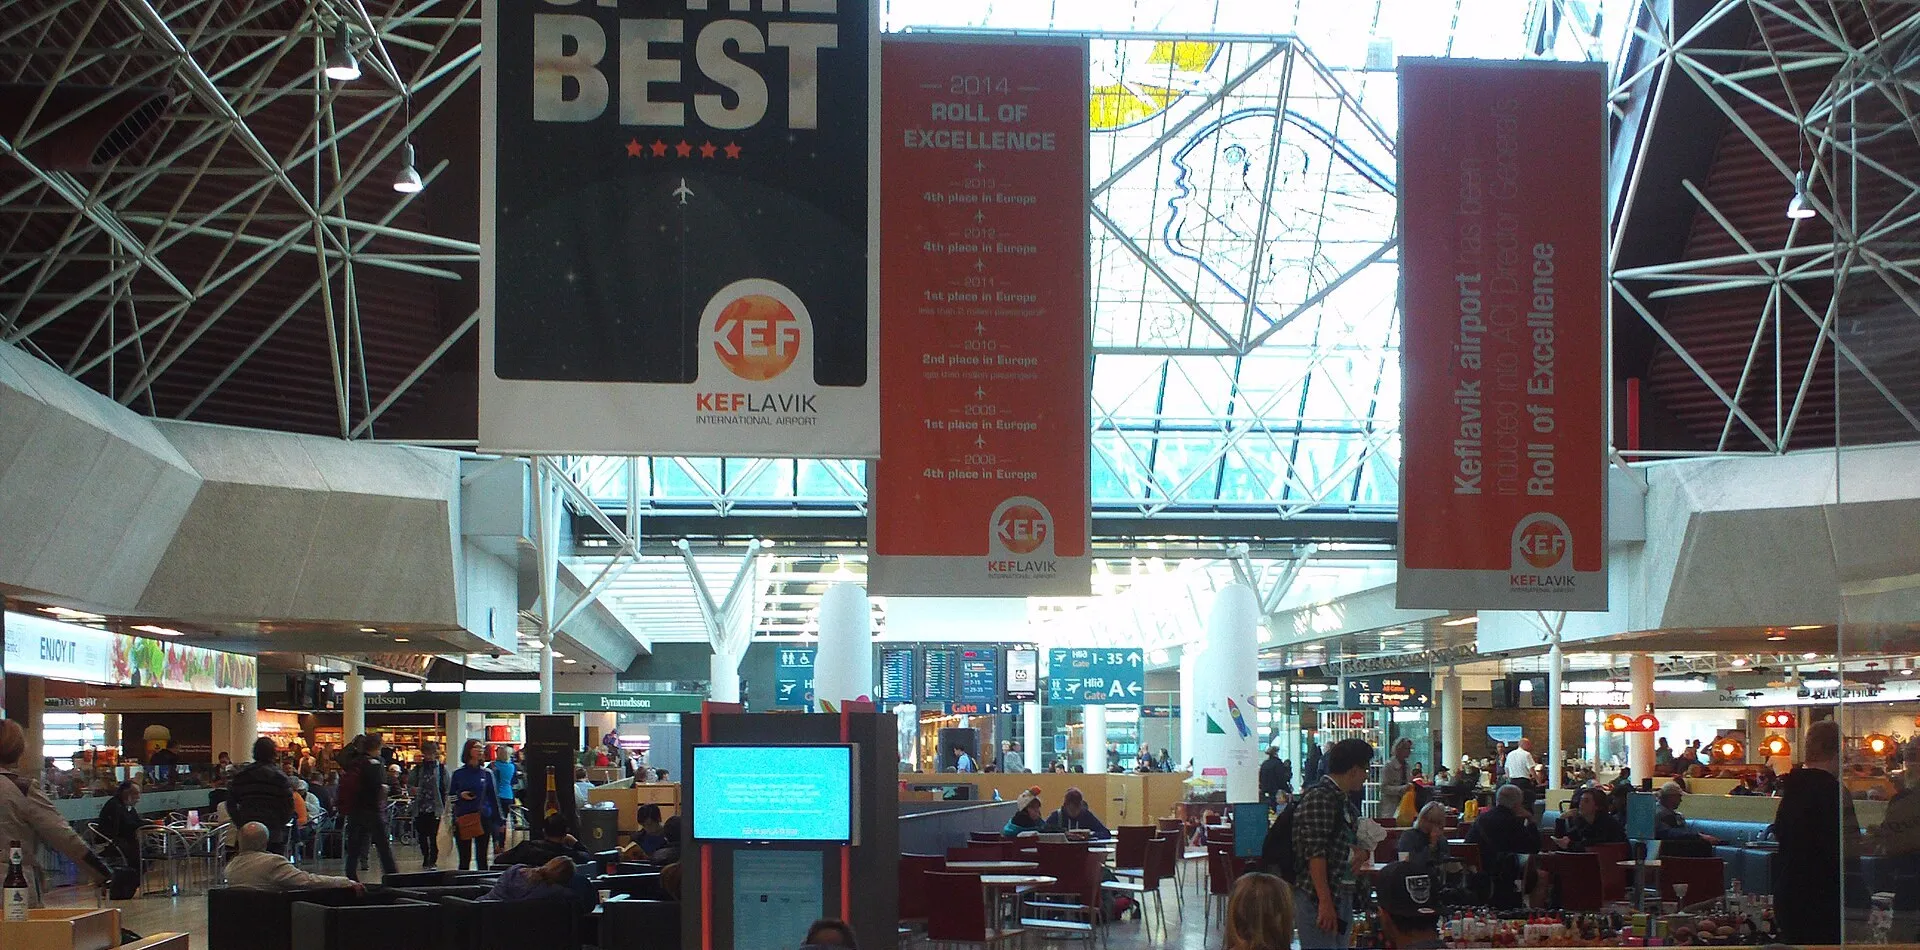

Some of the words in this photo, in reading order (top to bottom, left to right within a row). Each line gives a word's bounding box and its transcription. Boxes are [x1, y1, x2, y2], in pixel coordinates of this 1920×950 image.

[533, 13, 838, 129] BEST
[950, 75, 1011, 96] 2014
[931, 102, 990, 122] ROLL
[998, 103, 1029, 122] OF
[903, 129, 1056, 151] EXCELLENCE
[922, 191, 944, 203] 4th
[947, 192, 978, 205] place
[981, 192, 992, 203] in
[996, 192, 1038, 206] Europe
[922, 240, 944, 252] 4th
[947, 241, 978, 255] place
[982, 242, 993, 253] in
[996, 242, 1038, 255] Europe
[1455, 222, 1482, 264] has
[963, 276, 995, 288] 2011
[923, 290, 944, 302] 1st
[947, 291, 978, 304] place
[981, 291, 992, 302] in
[996, 291, 1037, 305] Europe
[1453, 271, 1488, 371] airport
[1527, 242, 1555, 395] Excellence
[712, 319, 801, 357] KEF
[963, 339, 997, 351] 2010
[922, 353, 945, 365] 2nd
[949, 354, 979, 367] place
[982, 354, 993, 365] in
[997, 354, 1038, 368] Europe
[696, 392, 818, 413] KEFLAVIK
[963, 404, 997, 416] 2009
[696, 415, 773, 426] INTERNATIONAL
[775, 416, 818, 426] AIRPORT
[923, 418, 944, 430] 1st
[947, 419, 978, 432] place
[982, 419, 993, 430] in
[996, 420, 1038, 432] Europe
[1526, 403, 1555, 434] of
[1453, 379, 1482, 496] Keflavik
[963, 454, 997, 465] 2008
[922, 467, 944, 479] 4th
[948, 468, 979, 481] place
[982, 468, 993, 479] in
[997, 468, 1038, 482] Europe
[1527, 443, 1555, 496] Roll
[996, 519, 1047, 541] KEF
[1519, 534, 1567, 555] KEF
[987, 560, 1057, 573] KEFLAVIK
[1510, 573, 1576, 587] KEFLAVIK
[40, 636, 67, 662] ENJOY
[68, 641, 76, 664] IT
[1072, 660, 1090, 668] Gate
[1106, 652, 1124, 665] 35
[1083, 677, 1104, 688] Hlið
[1108, 679, 1126, 698] A
[1084, 690, 1107, 700] Gate
[335, 693, 406, 705] Endsson
[600, 697, 651, 709] Eymundsson
[951, 703, 978, 713] Gate
